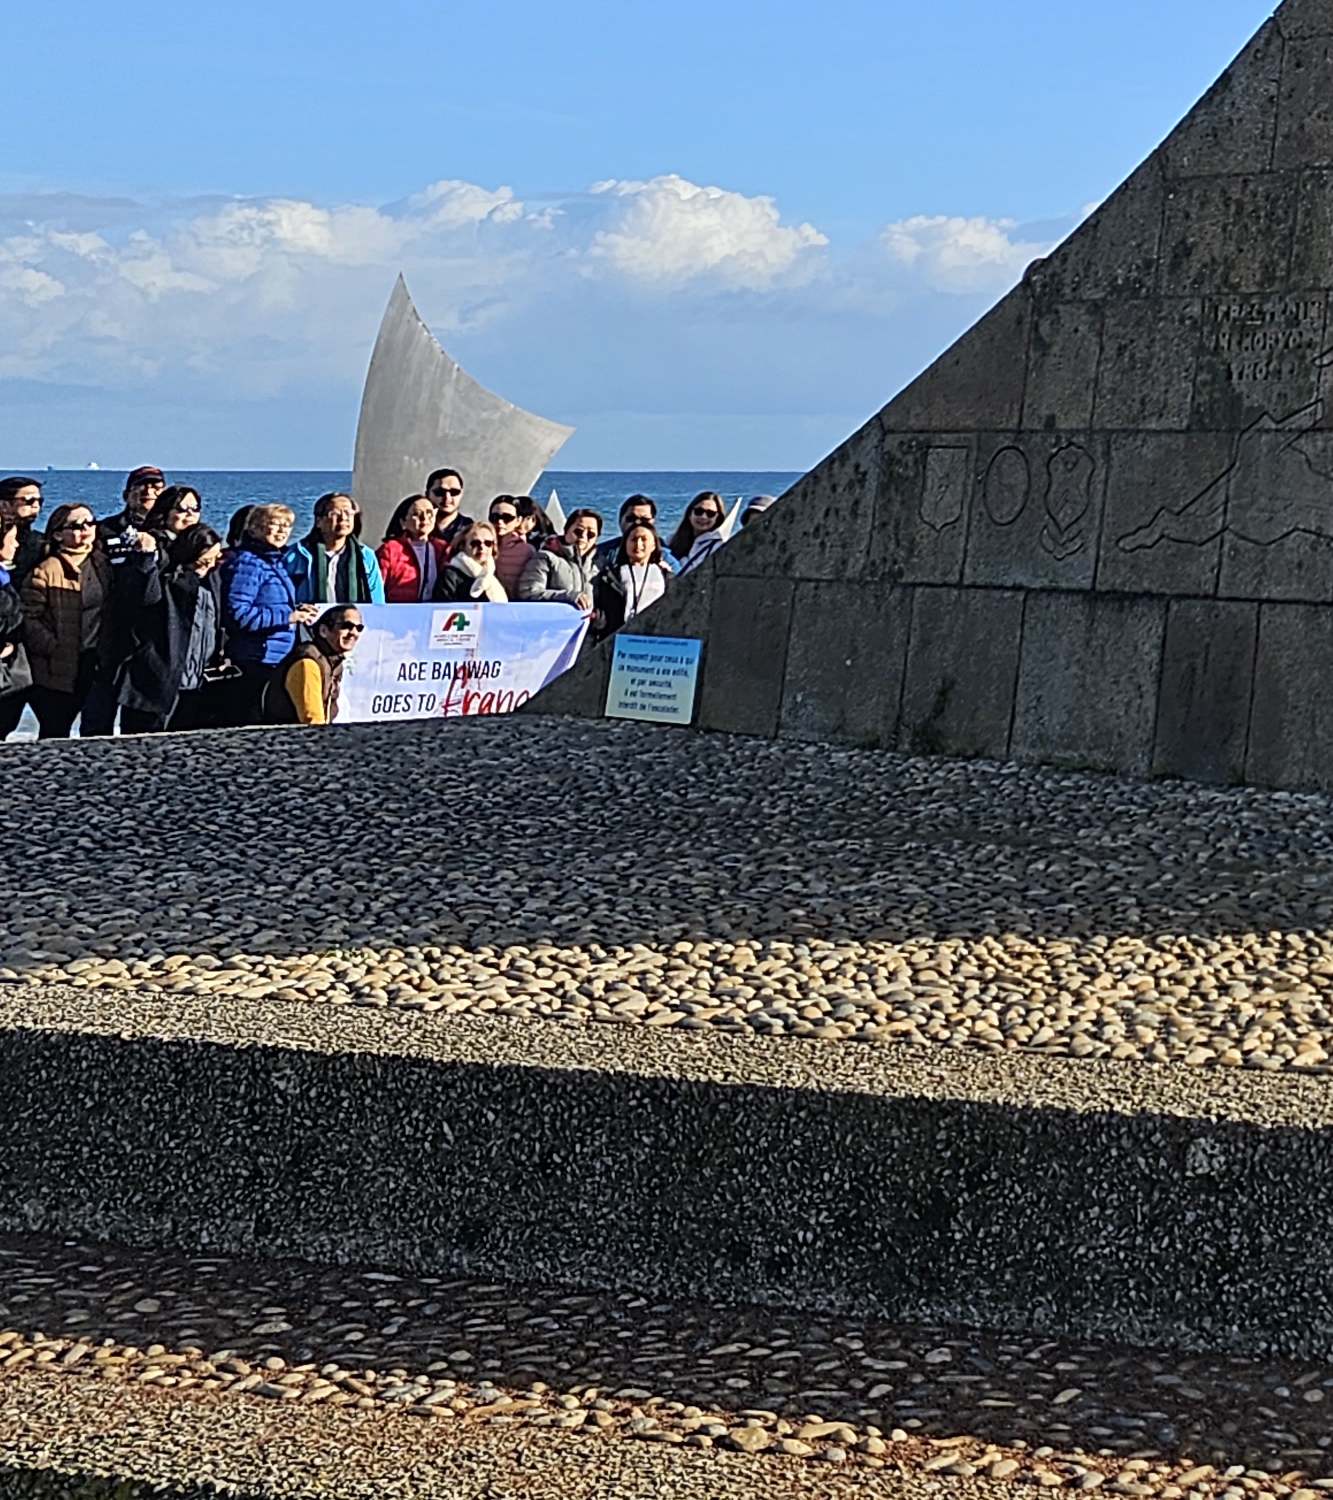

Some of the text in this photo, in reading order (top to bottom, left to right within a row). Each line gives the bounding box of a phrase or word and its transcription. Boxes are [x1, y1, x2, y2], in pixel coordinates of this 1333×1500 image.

[397, 662, 428, 682] ACE
[372, 694, 412, 714] GOES
[418, 693, 436, 712] TO
